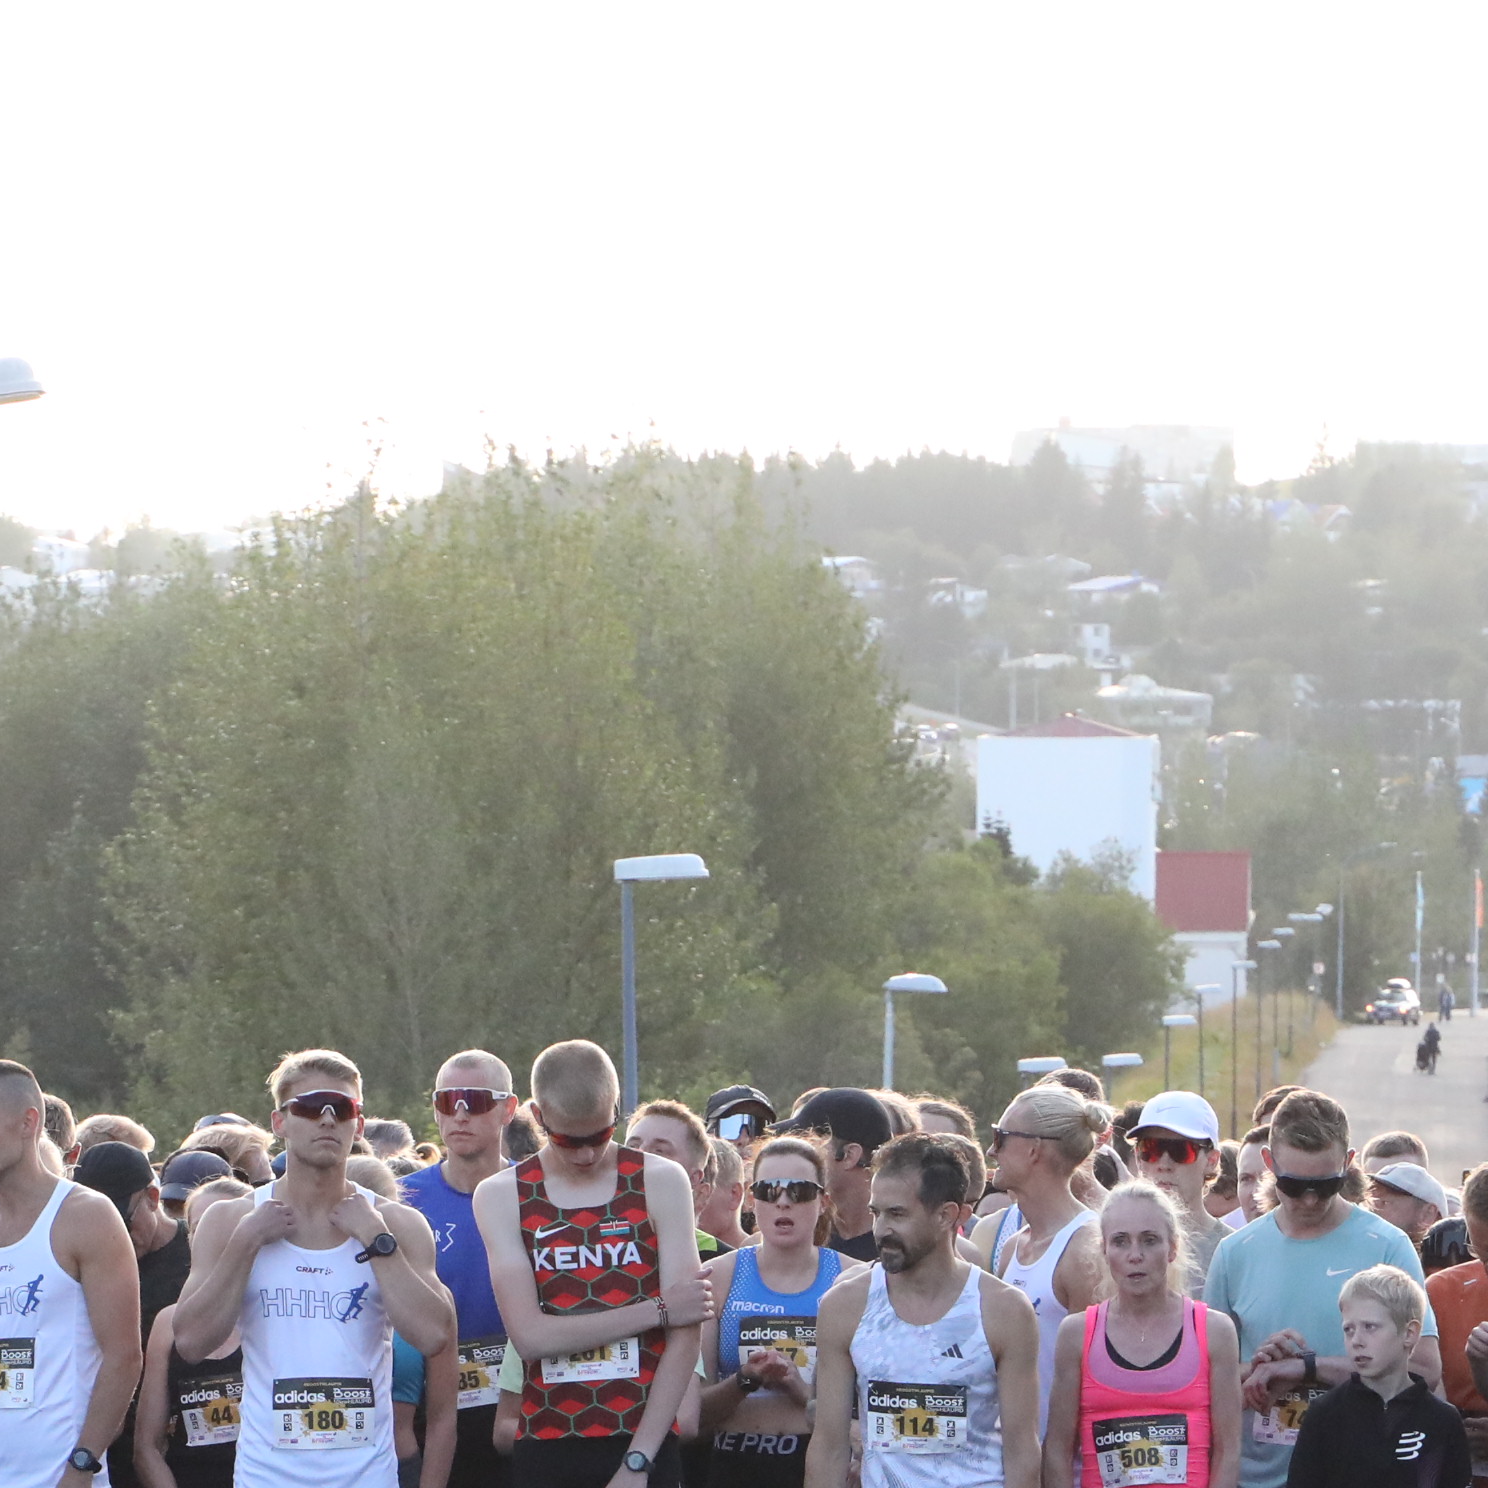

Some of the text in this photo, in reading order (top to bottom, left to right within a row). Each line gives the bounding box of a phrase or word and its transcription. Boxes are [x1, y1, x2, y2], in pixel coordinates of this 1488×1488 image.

[533, 1241, 642, 1271] KENYA
[296, 1265, 324, 1274] CRAFT
[731, 1300, 785, 1314] macron
[740, 1327, 788, 1340] adidas
[180, 1389, 221, 1404] adidas
[274, 1390, 326, 1404] adidas
[333, 1388, 371, 1399] Boost
[869, 1394, 965, 1409] adidas Boost
[212, 1406, 233, 1425] 44
[305, 1410, 344, 1430] 180
[896, 1416, 935, 1436] 114
[740, 1433, 798, 1455] PRO
[1095, 1430, 1141, 1446] adidas
[1148, 1426, 1186, 1436] Boost
[1120, 1447, 1160, 1468] 508
